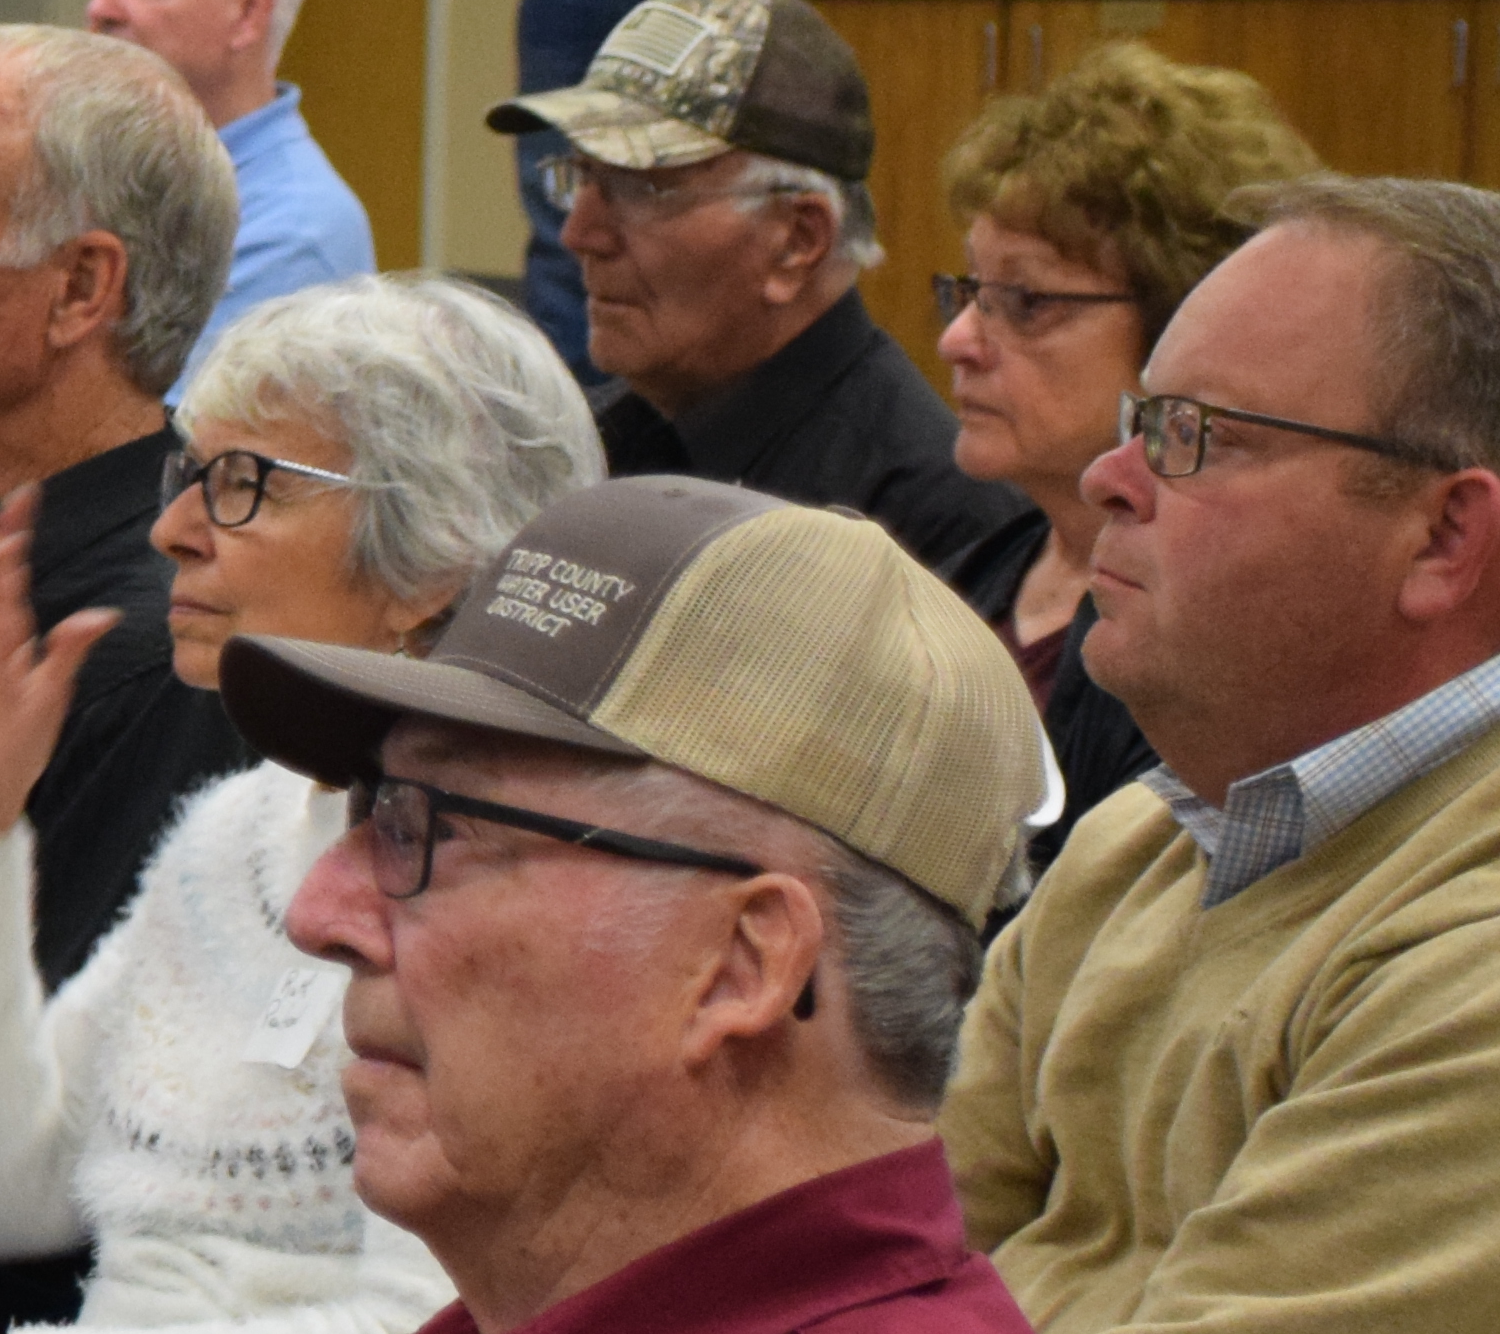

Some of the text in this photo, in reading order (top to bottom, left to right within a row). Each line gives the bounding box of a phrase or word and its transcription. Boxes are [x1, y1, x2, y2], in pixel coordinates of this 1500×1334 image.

[549, 559, 636, 602] COUNTY
[486, 595, 573, 638] DISTRICT
[549, 588, 607, 626] USER
